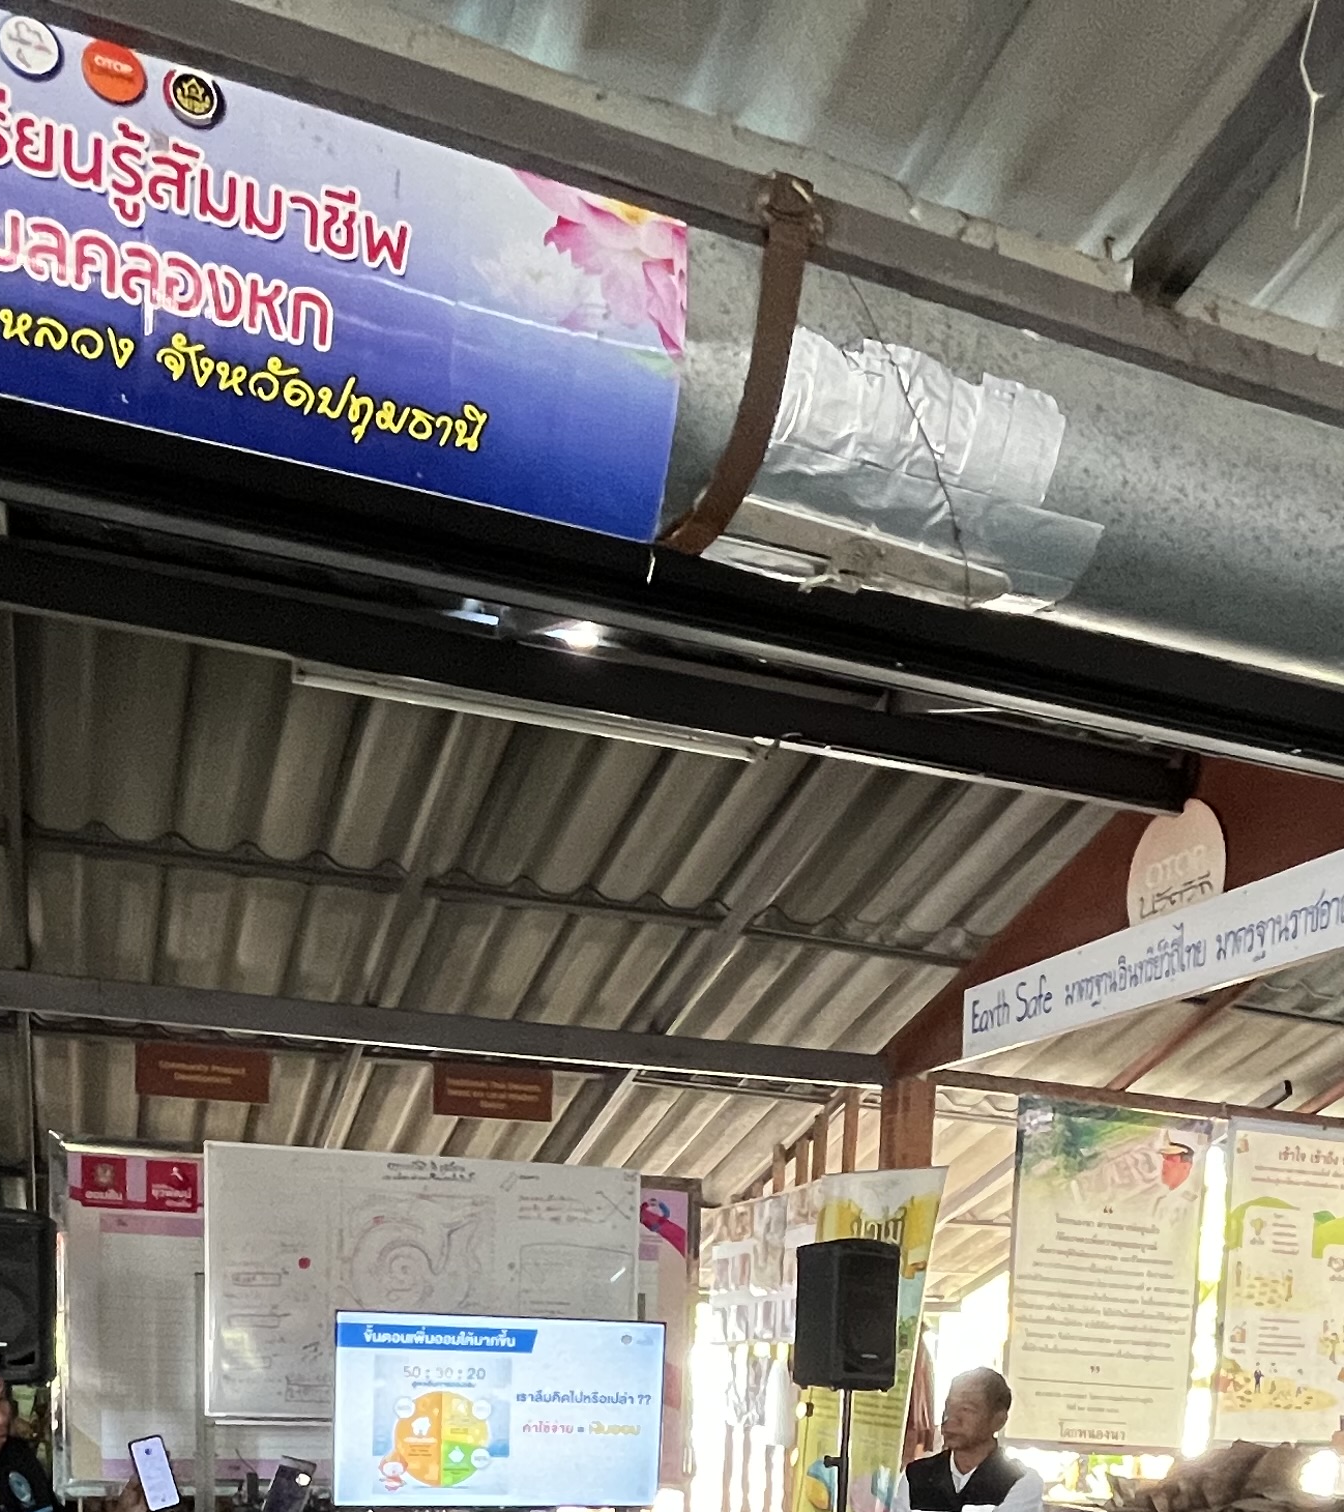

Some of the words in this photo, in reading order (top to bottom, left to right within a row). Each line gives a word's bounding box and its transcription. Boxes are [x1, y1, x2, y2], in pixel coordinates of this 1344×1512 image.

[93, 53, 134, 74] OTOP
[158, 335, 487, 452] จังหวัดปทุมธานี
[972, 989, 1010, 1034] Earth
[1015, 974, 1053, 1022] Safe
[403, 1365, 422, 1379] 50
[466, 1367, 486, 1380] 20
